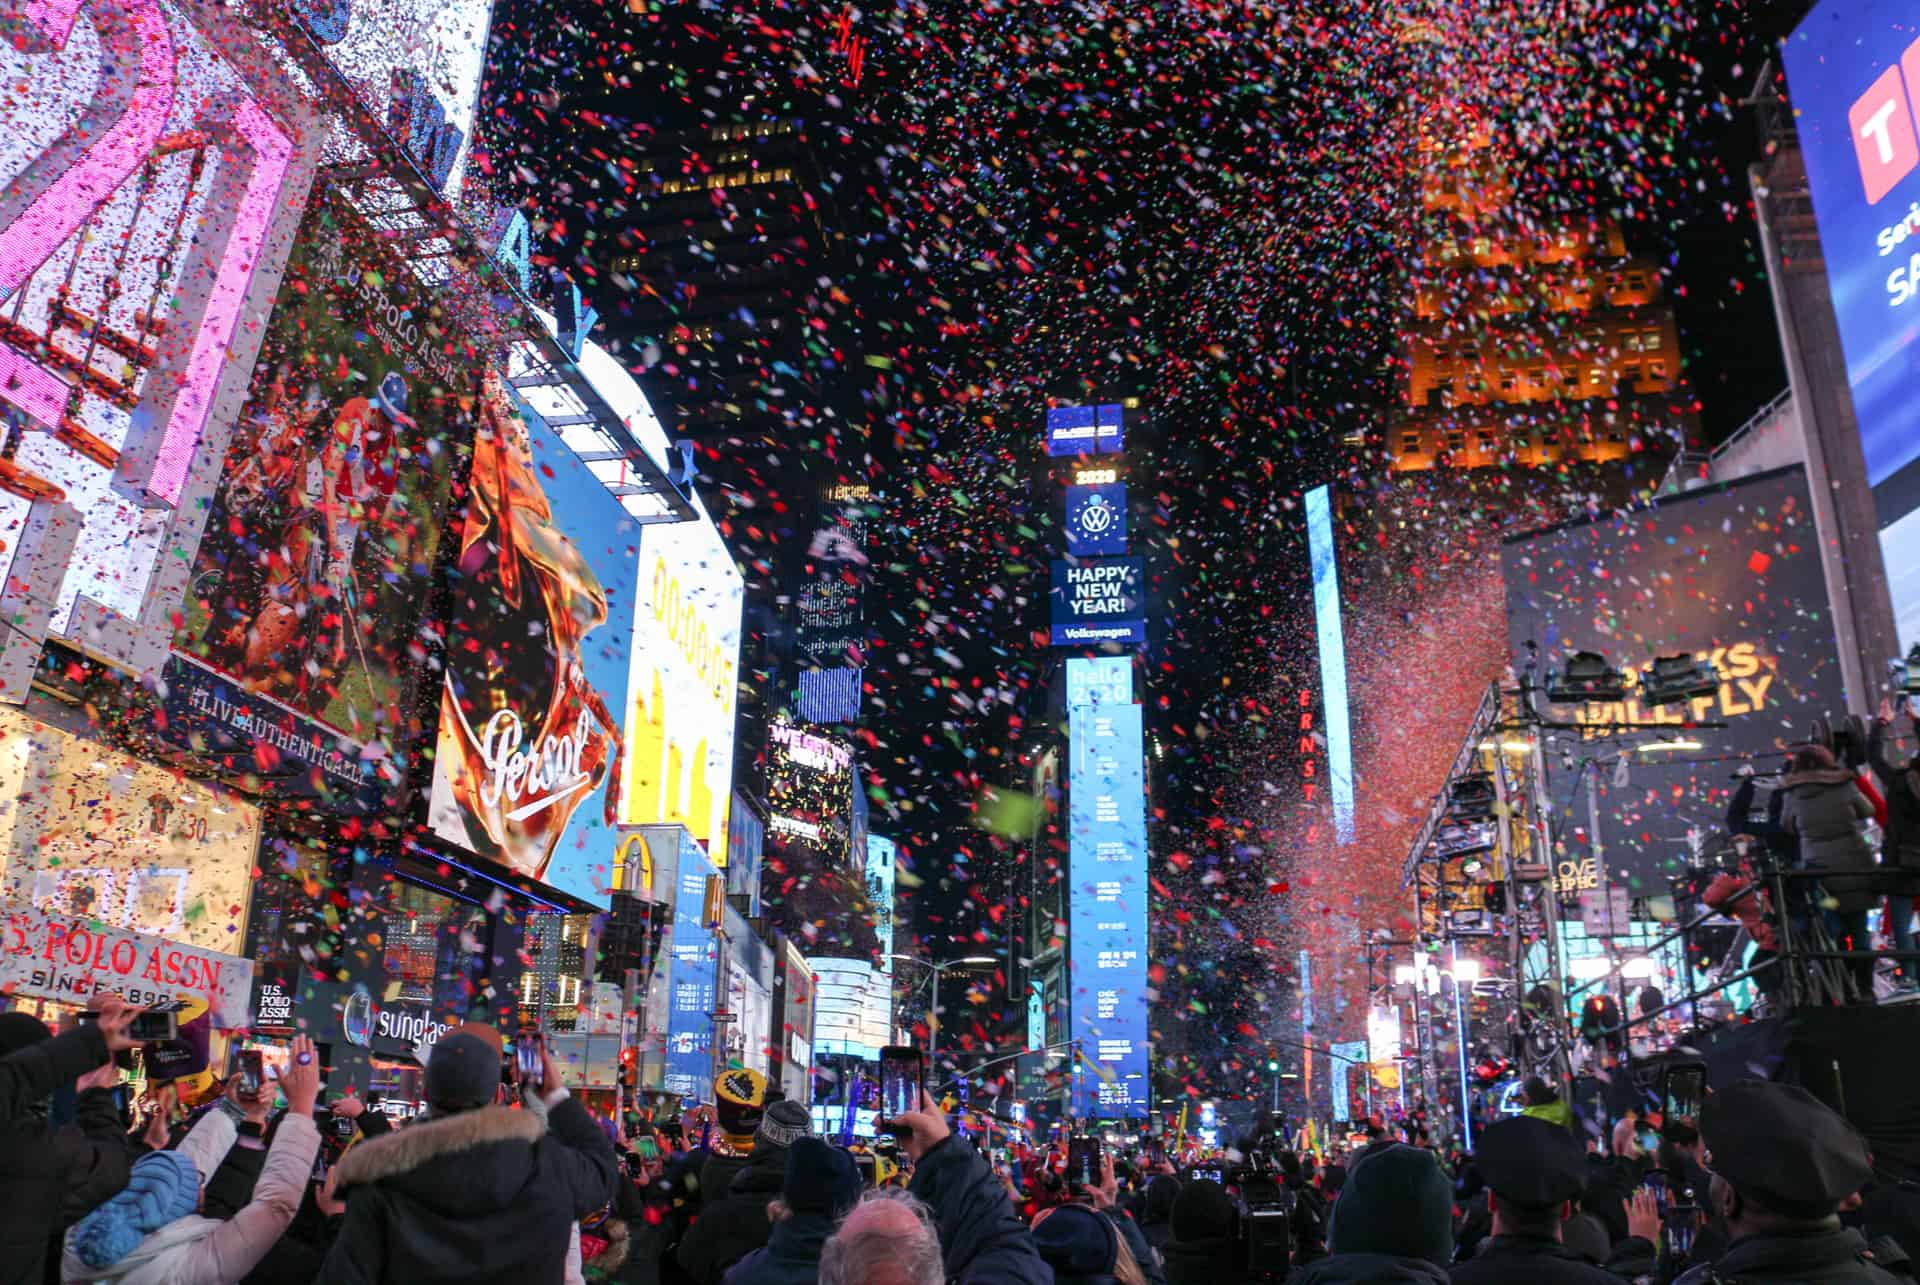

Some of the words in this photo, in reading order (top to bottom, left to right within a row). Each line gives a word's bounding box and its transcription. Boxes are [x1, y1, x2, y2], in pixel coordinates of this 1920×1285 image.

[1067, 566, 1130, 583] HAPPY
[1075, 582, 1121, 599] NEW
[1069, 598, 1126, 615] YEAR!
[480, 708, 591, 808] Persol
[43, 922, 137, 976] POLO
[141, 945, 226, 995] ASSN.
[262, 984, 283, 996] U.S.
[260, 996, 290, 1007] POLO
